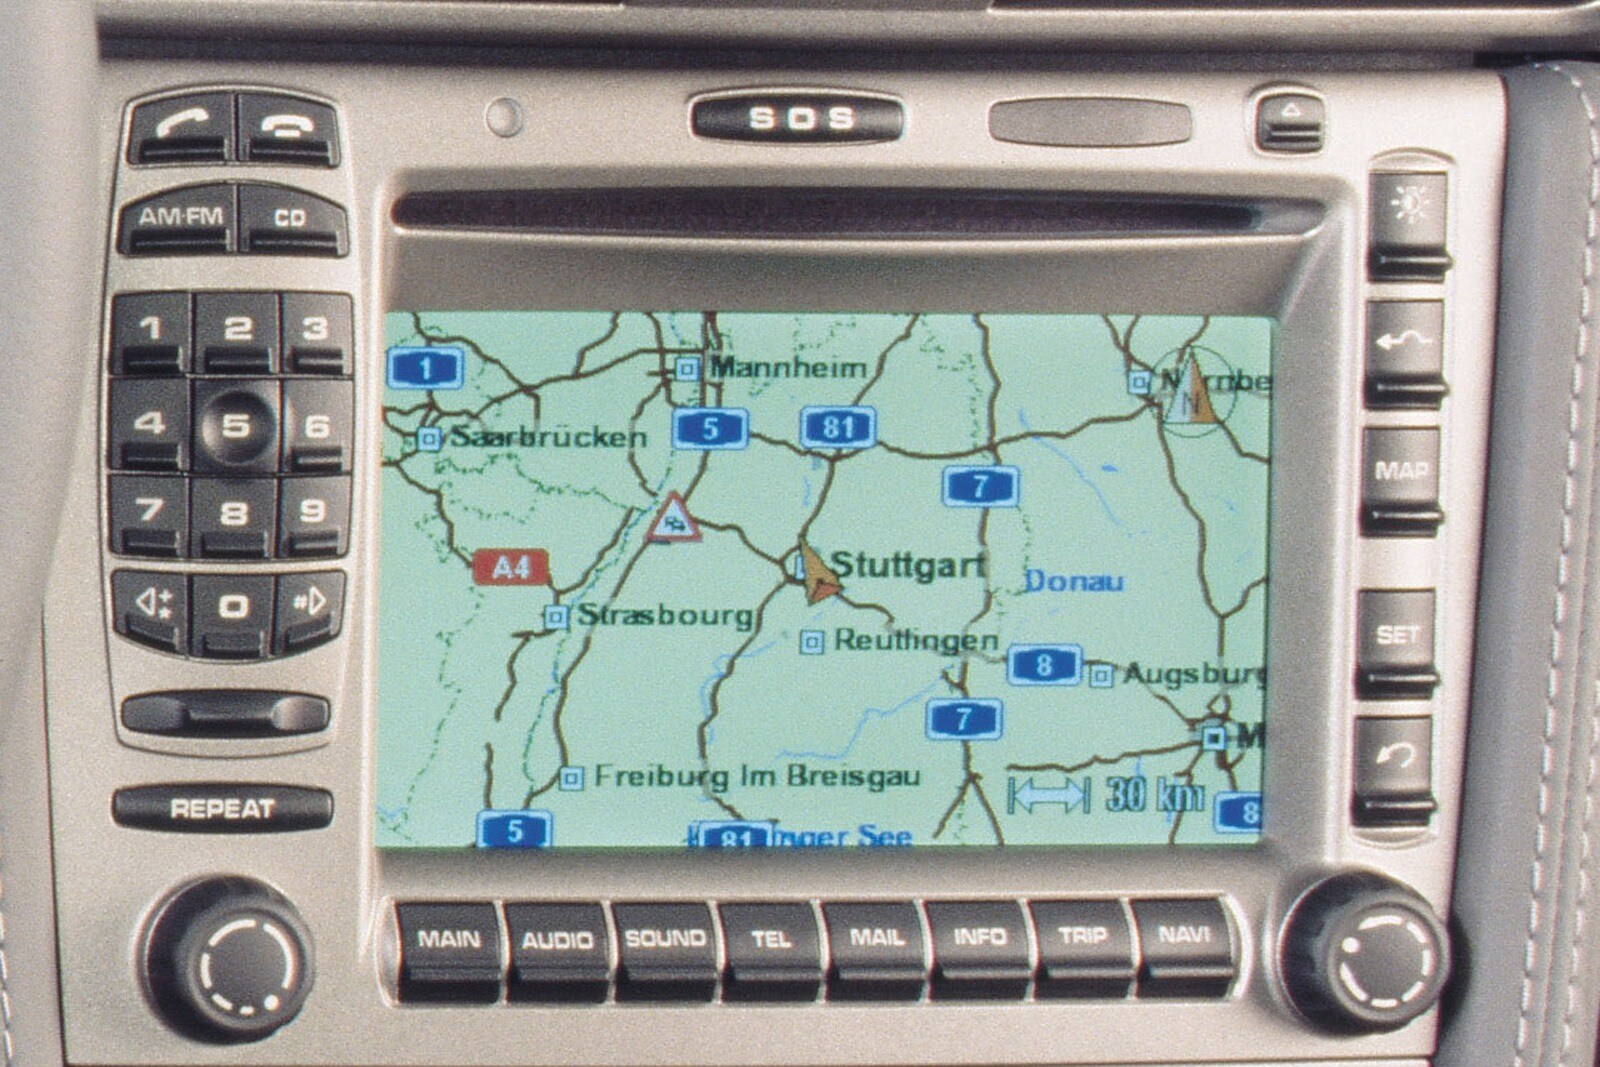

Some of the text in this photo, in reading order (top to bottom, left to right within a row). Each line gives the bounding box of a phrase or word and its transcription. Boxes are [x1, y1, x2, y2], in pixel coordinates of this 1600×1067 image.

[749, 106, 856, 131] SOS
[274, 208, 306, 227] CD
[140, 315, 161, 340] 1
[224, 315, 253, 341] 2
[302, 316, 328, 340] 3
[420, 358, 431, 381] 1
[710, 355, 867, 379] Mannheim
[134, 411, 165, 435] 4
[222, 414, 250, 438] 5
[305, 415, 331, 438] 6
[703, 418, 718, 441] 5
[823, 416, 853, 439] 81
[450, 424, 648, 449] Saarbrücken
[1374, 461, 1430, 480] MAP
[973, 474, 988, 499] 7
[136, 498, 164, 521] 7
[220, 502, 248, 526] 8
[300, 499, 326, 522] 9
[492, 554, 531, 580] A4
[831, 551, 987, 584] Stuttgart
[1025, 568, 1124, 593] Donau
[219, 595, 248, 619] 0
[578, 603, 753, 632] Strasbourg
[1376, 625, 1420, 645] SET
[1037, 653, 1052, 677] 8
[955, 707, 972, 732] 7
[594, 764, 730, 793] Freiburg
[787, 763, 922, 793] Breisgau
[1105, 775, 1206, 812] 30 km
[170, 799, 275, 820] REPEAT
[1243, 801, 1259, 824] 8
[507, 820, 523, 842] 5
[417, 930, 481, 949] MAIN
[521, 931, 595, 950] AUDIO
[625, 929, 707, 948] SOUND
[751, 930, 792, 949] TEL
[850, 928, 907, 947] MAIL
[954, 927, 1008, 946] INFO
[1058, 926, 1108, 945] TRIP
[1158, 925, 1211, 944] NAVI
